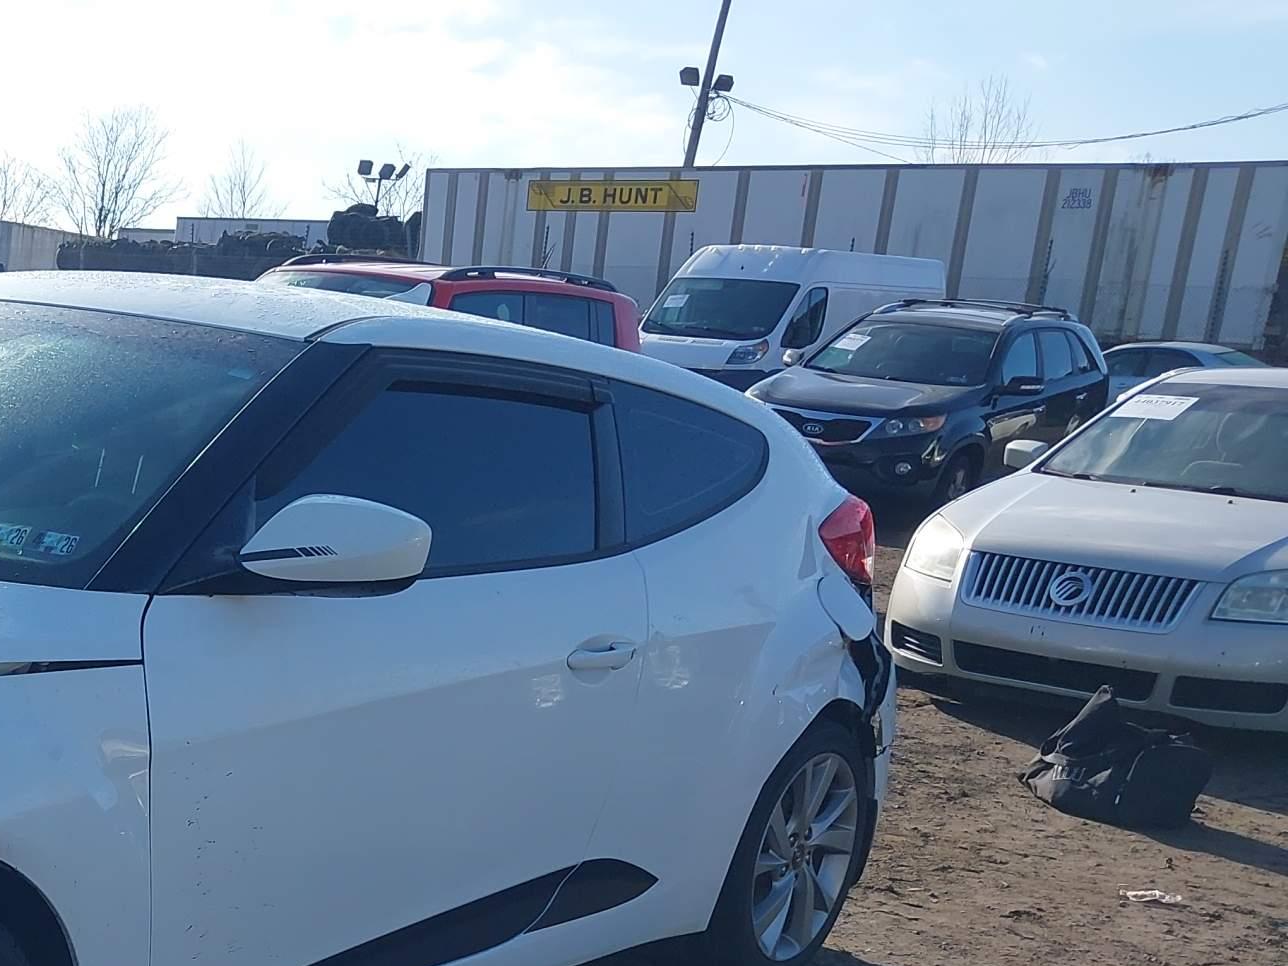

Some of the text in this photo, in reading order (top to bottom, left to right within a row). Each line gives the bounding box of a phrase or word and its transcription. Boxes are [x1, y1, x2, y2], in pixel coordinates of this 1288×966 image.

[559, 187, 663, 205] J.B. HUNT
[9, 528, 28, 546] 26
[59, 536, 79, 554] 26
